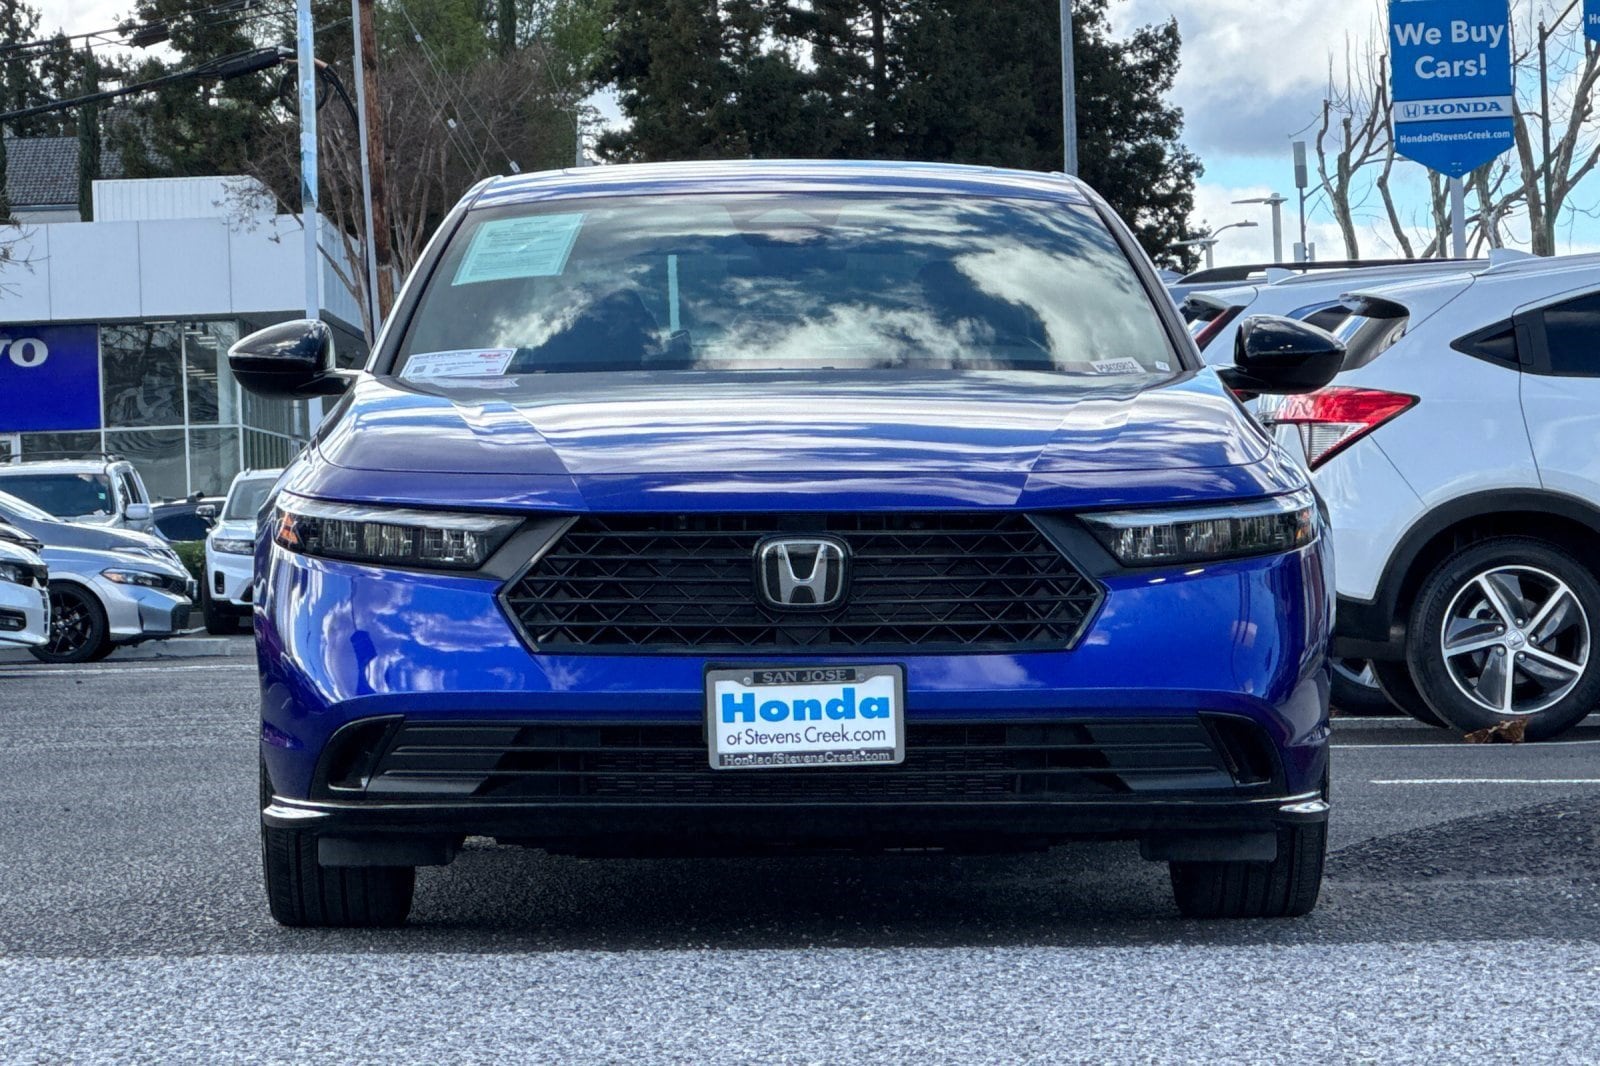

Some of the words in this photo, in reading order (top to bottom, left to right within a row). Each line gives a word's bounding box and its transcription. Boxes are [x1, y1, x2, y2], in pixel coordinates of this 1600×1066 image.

[1394, 22, 1442, 46] We
[1450, 20, 1505, 48] Buy
[1414, 53, 1487, 79] Cars!
[1423, 101, 1504, 115] HONDA
[1400, 130, 1511, 144] HondaofStevensCreek.com
[762, 671, 797, 683] SAN
[803, 669, 847, 682] JOSE
[721, 687, 890, 723] Honda
[726, 731, 743, 746] of
[745, 728, 801, 745] Stevens
[804, 723, 886, 743] Creek.com
